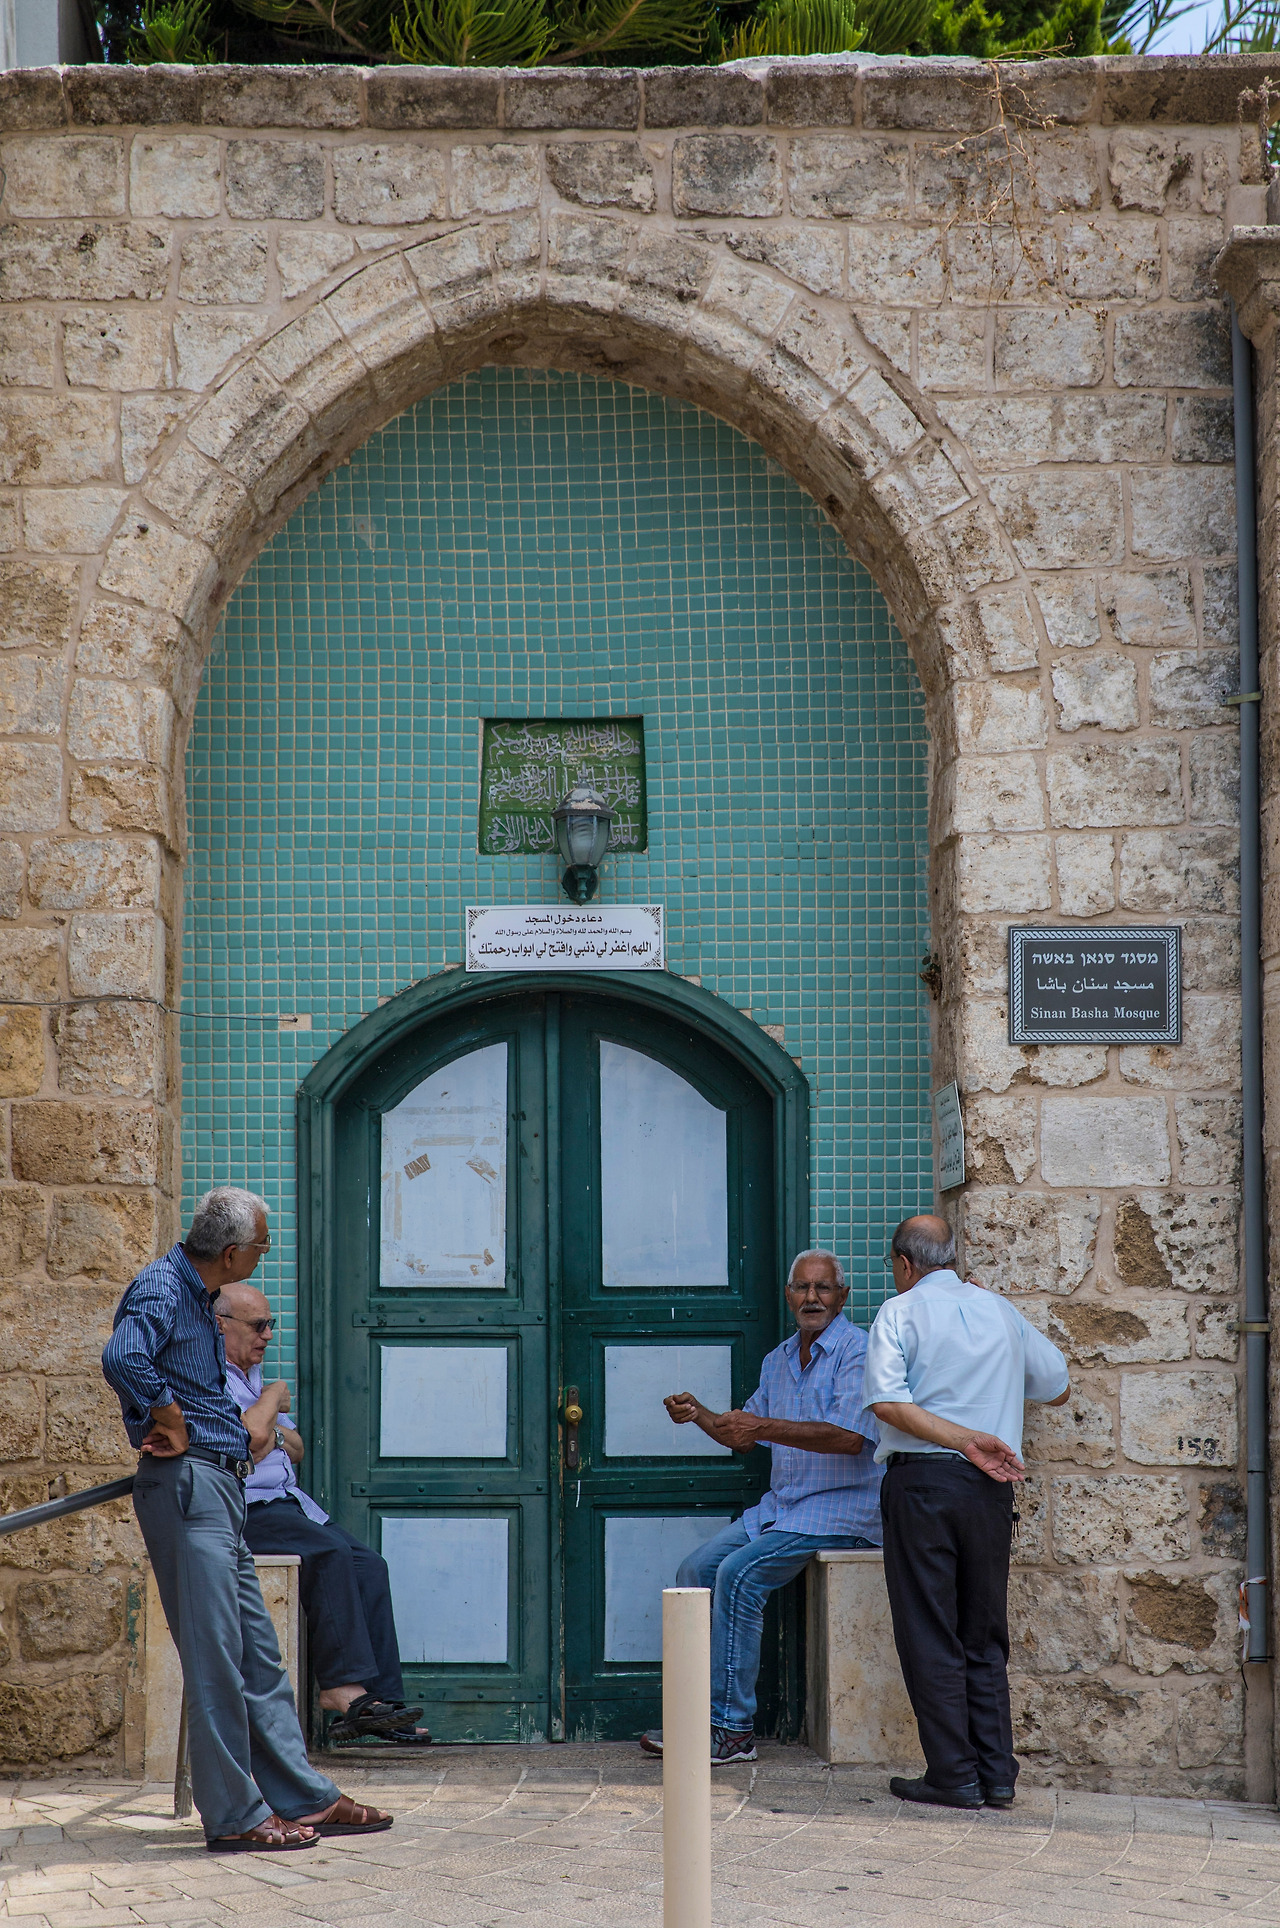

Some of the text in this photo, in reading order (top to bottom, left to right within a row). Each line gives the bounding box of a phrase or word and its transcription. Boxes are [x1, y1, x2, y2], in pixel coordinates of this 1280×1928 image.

[525, 914, 602, 925] دعاء دخول المسجد
[534, 928, 556, 936] والسلام
[478, 942, 511, 957] رحمتك
[536, 941, 547, 958] لي
[574, 941, 595, 958] ذنبي
[596, 941, 607, 958] لي
[631, 941, 652, 956] اللهم
[1031, 952, 1159, 967] מסגד סנאן באשה
[1036, 977, 1155, 993] مسجد سنان باشا
[1030, 1007, 1160, 1021] Sinan Basha Mosque
